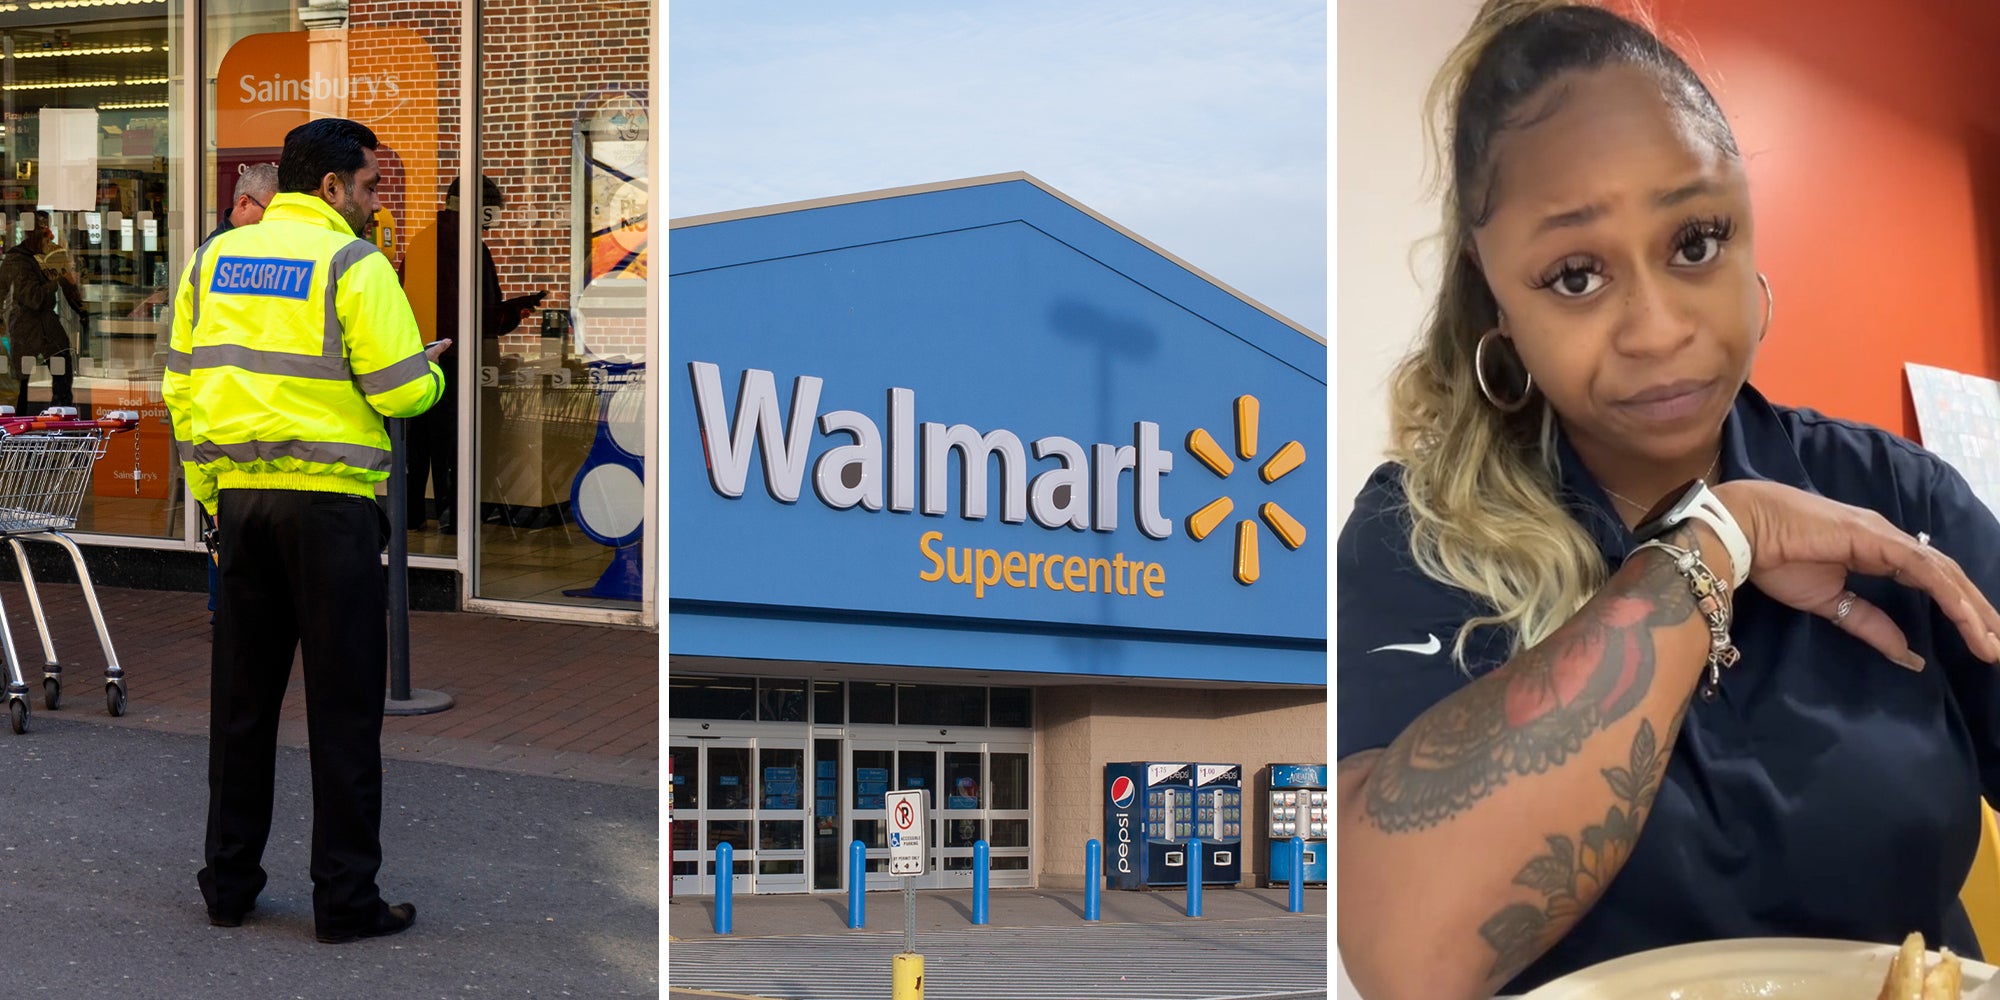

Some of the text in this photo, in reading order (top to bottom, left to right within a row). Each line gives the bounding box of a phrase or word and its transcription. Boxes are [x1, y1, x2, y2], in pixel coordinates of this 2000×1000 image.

[239, 69, 400, 105] Sainsbury's
[217, 262, 308, 292] SECURITY
[118, 397, 142, 407] Food
[688, 361, 1174, 539] Walmart
[919, 531, 1166, 599] Supercentre
[1116, 813, 1131, 873] pepsi
